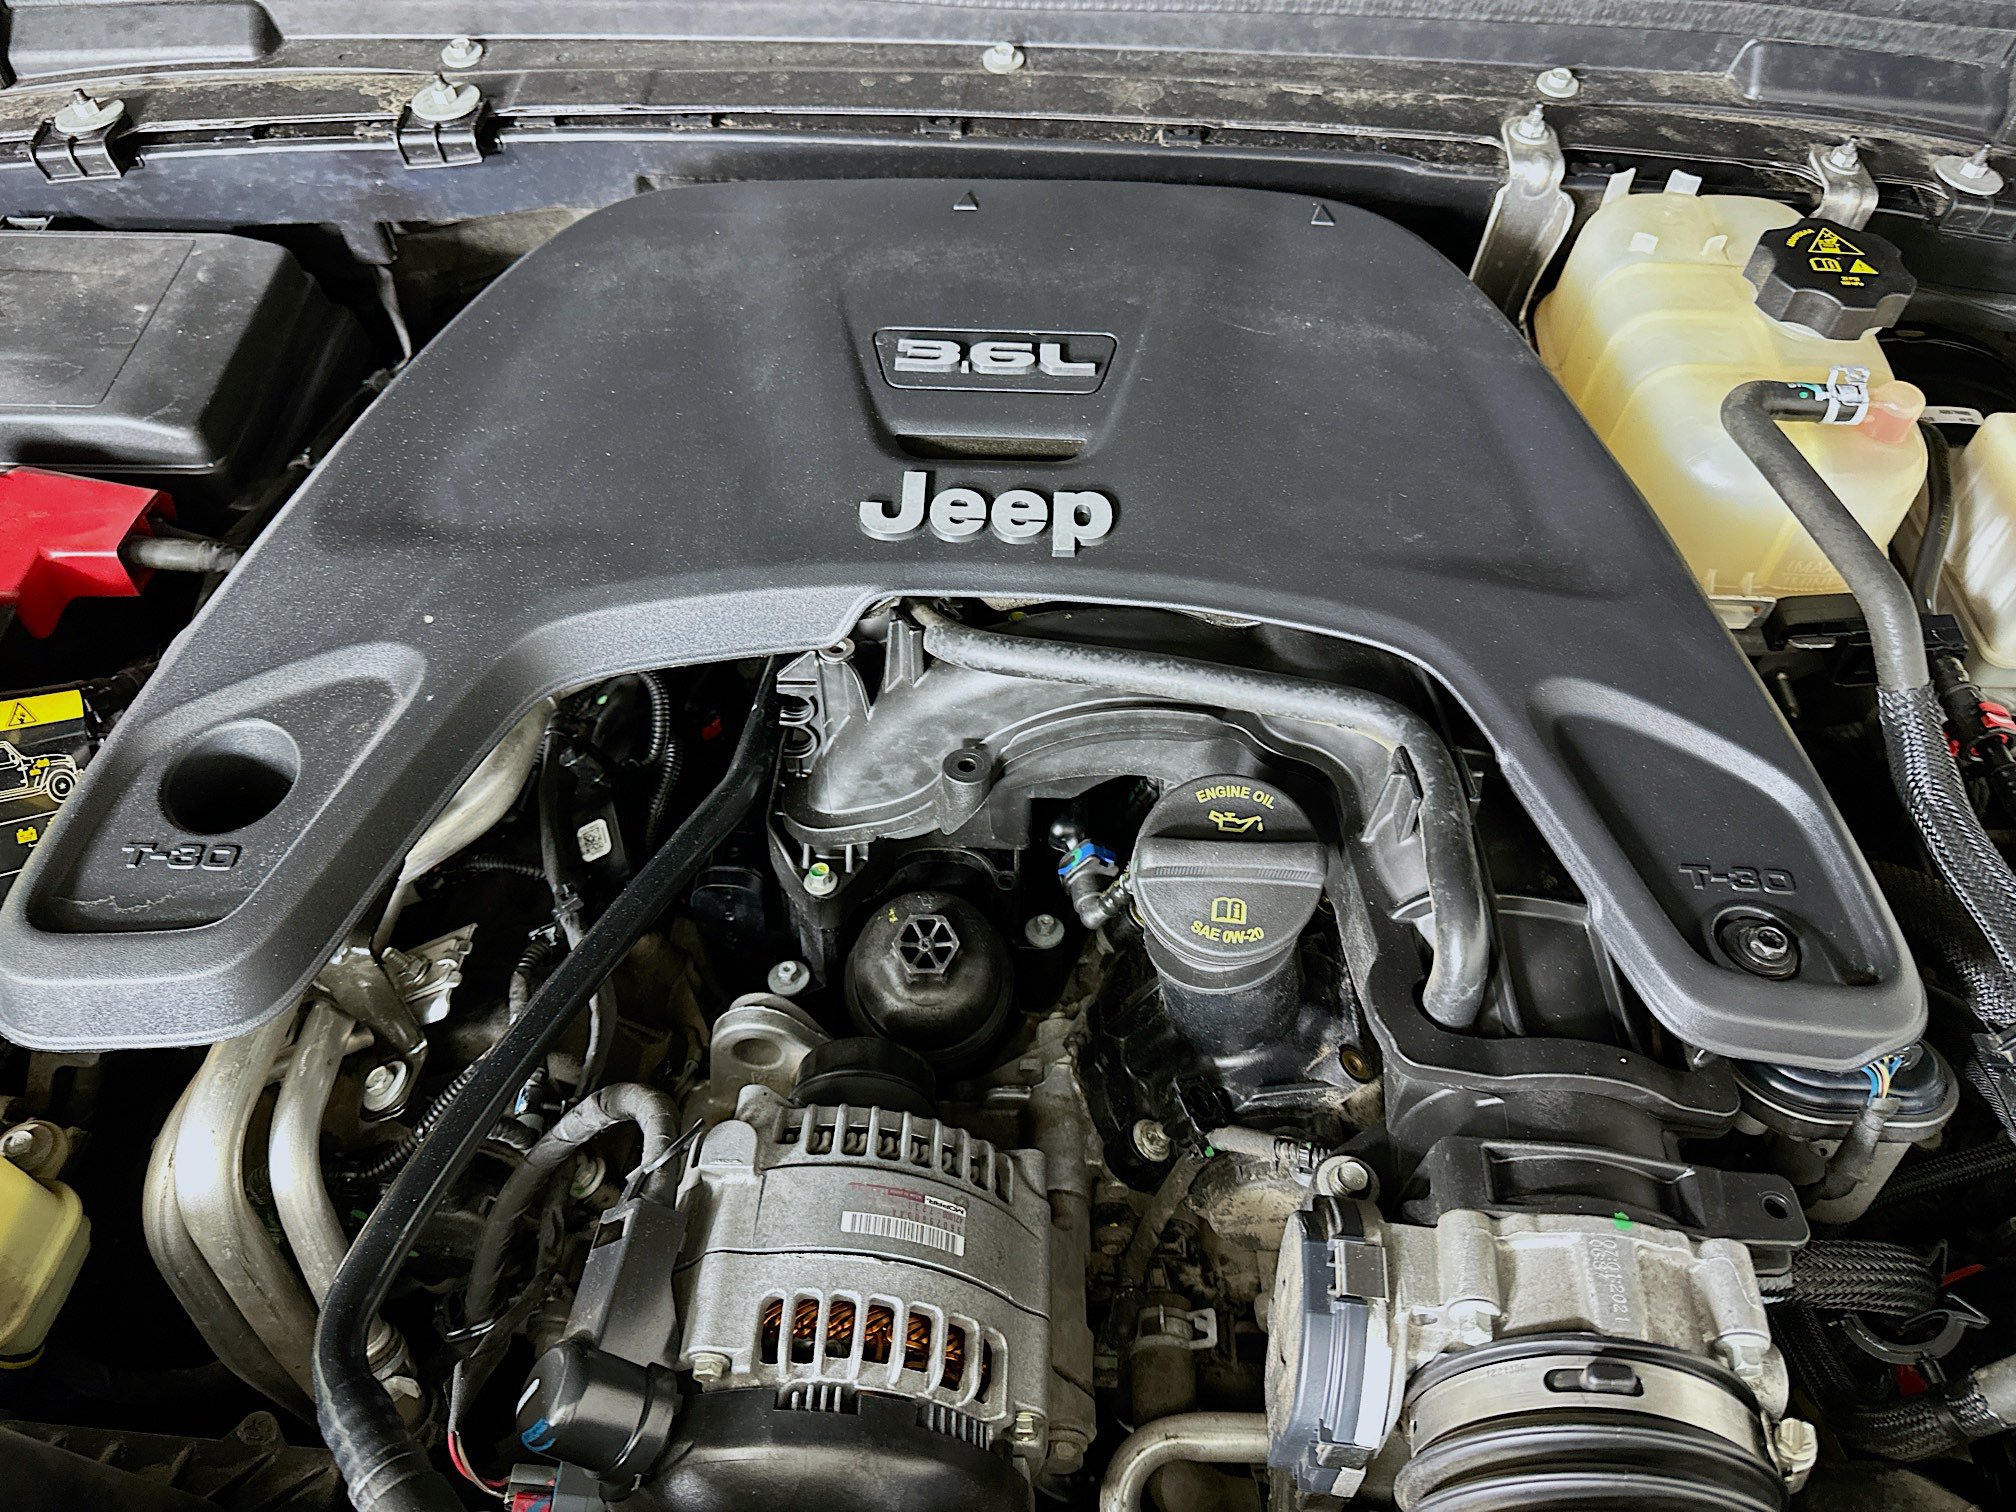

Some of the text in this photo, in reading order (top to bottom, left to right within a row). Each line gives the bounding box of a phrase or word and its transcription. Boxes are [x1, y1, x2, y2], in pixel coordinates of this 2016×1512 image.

[895, 339, 1096, 376] 3.6L
[859, 471, 1113, 557] Jeep
[1195, 785, 1275, 809] ENGINE OIL
[121, 843, 242, 871] T-30
[1679, 864, 1797, 895] T-30
[1190, 920, 1265, 944] SAE 0W-20
